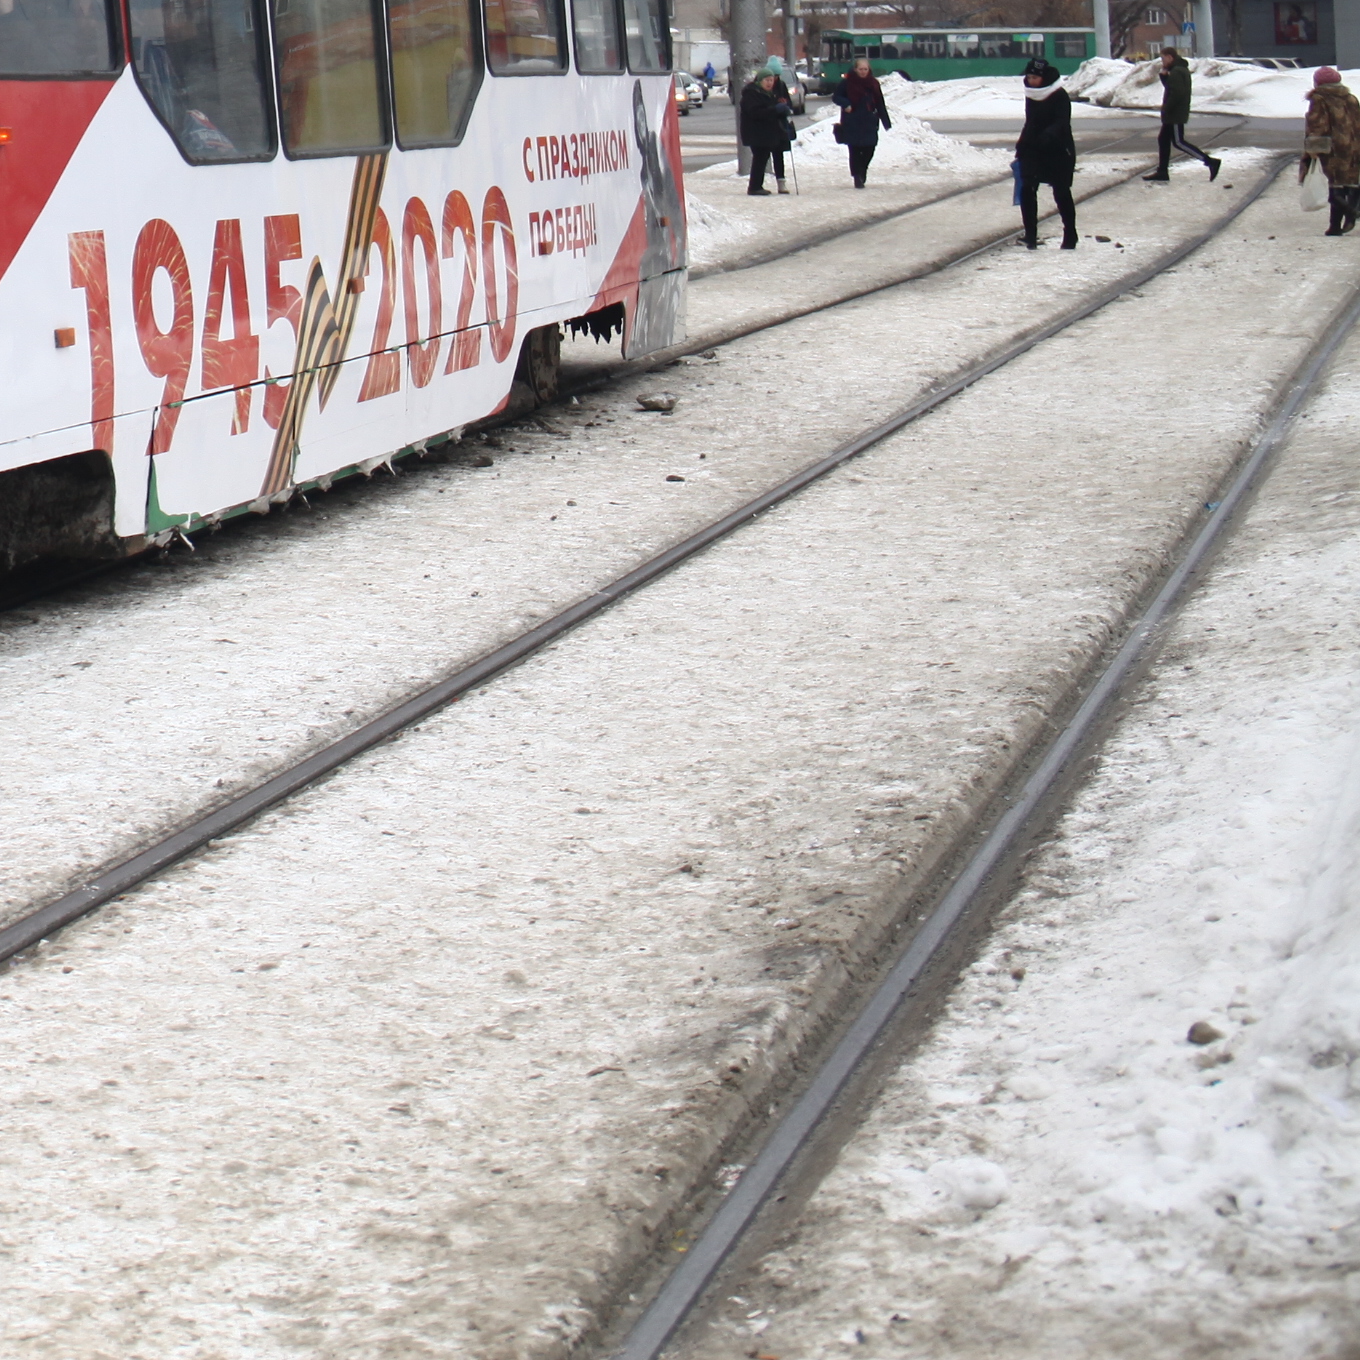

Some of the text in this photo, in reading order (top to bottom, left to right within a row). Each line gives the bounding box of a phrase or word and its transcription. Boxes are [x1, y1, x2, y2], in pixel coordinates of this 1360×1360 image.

[522, 129, 629, 185] С ПРАЗДНИКОМ
[529, 202, 597, 259] ПОБЕДЫ!
